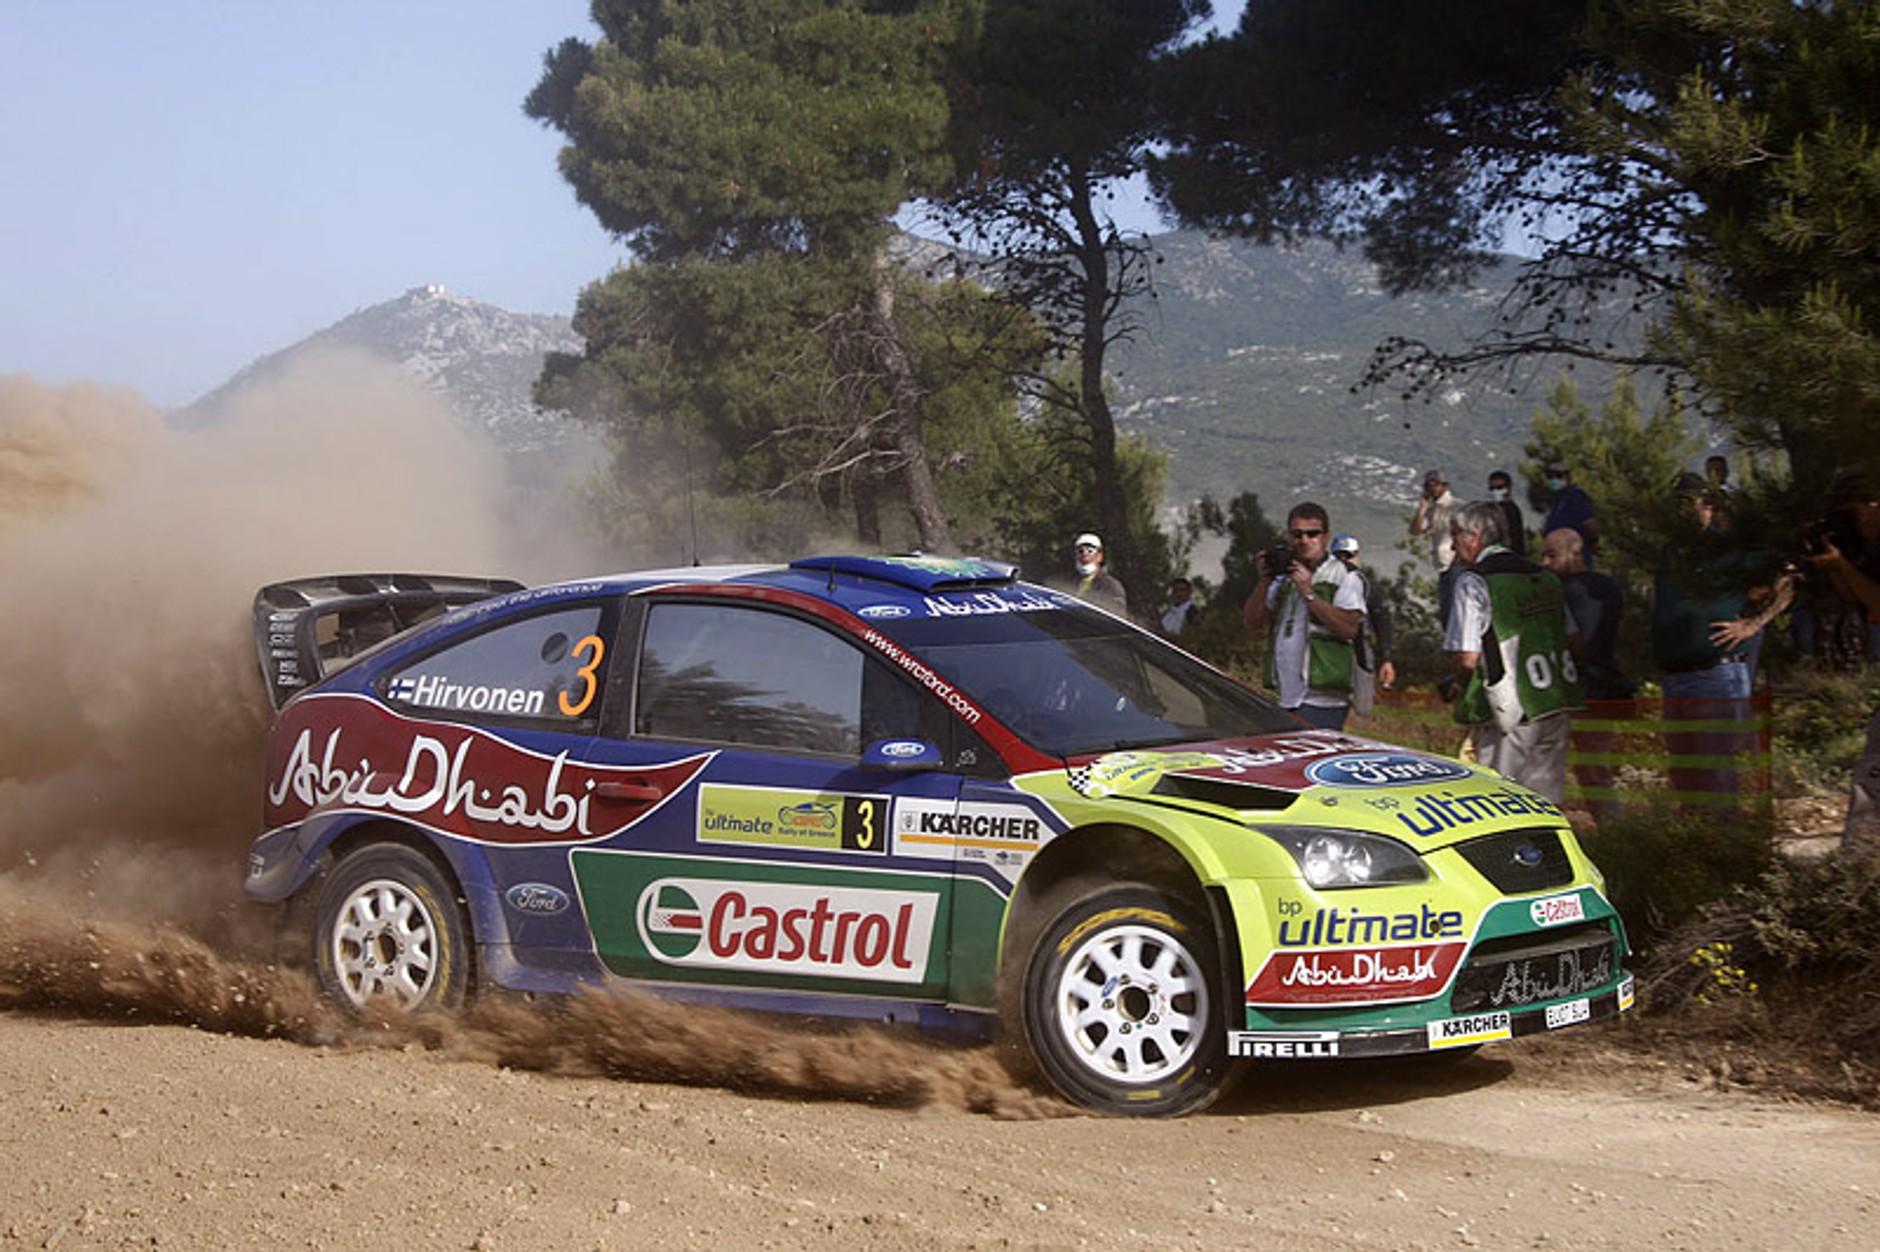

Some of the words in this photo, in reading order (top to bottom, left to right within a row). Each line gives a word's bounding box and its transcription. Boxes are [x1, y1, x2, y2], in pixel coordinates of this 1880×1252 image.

[558, 634, 605, 716] 3
[411, 676, 544, 713] Hirvonen
[269, 727, 392, 807] Abu
[392, 733, 594, 836] Dhabi
[1334, 755, 1453, 784] Ford
[704, 815, 774, 835] ultimate
[856, 800, 874, 850] 3
[920, 812, 1041, 840] KÄRCHER
[517, 887, 558, 910] Ford
[1278, 897, 1303, 917] bp
[708, 890, 914, 970] Castrol
[1278, 903, 1463, 946] ultimate
[1281, 954, 1344, 986] Abu
[1344, 950, 1438, 984] Dhabi
[1442, 1013, 1510, 1037] KÄRCHER
[1228, 1031, 1339, 1057] PIRELLI
